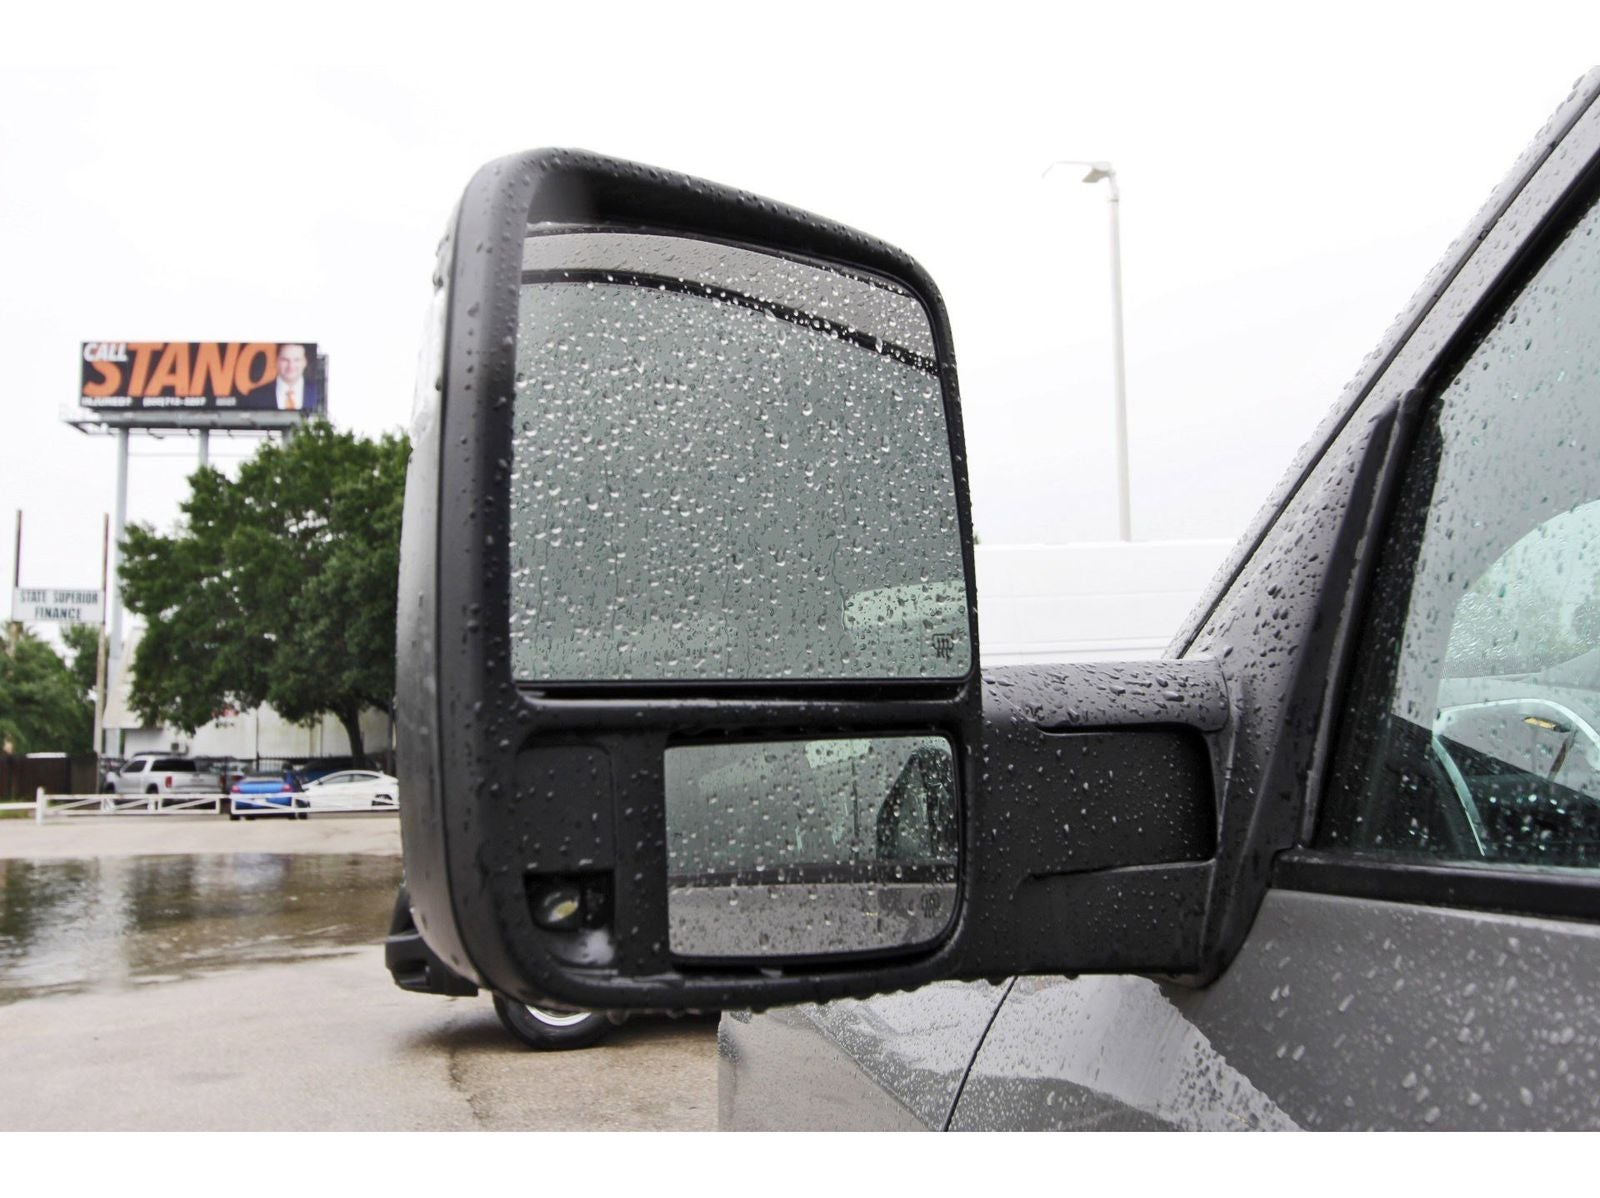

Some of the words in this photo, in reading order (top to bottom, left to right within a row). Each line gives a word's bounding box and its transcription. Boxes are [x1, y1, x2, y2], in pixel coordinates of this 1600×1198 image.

[83, 342, 128, 362] CALL
[82, 342, 277, 396] STANO
[20, 590, 46, 602] STATE
[54, 590, 98, 604] SUPERIOR
[34, 607, 81, 619] FINANCE
